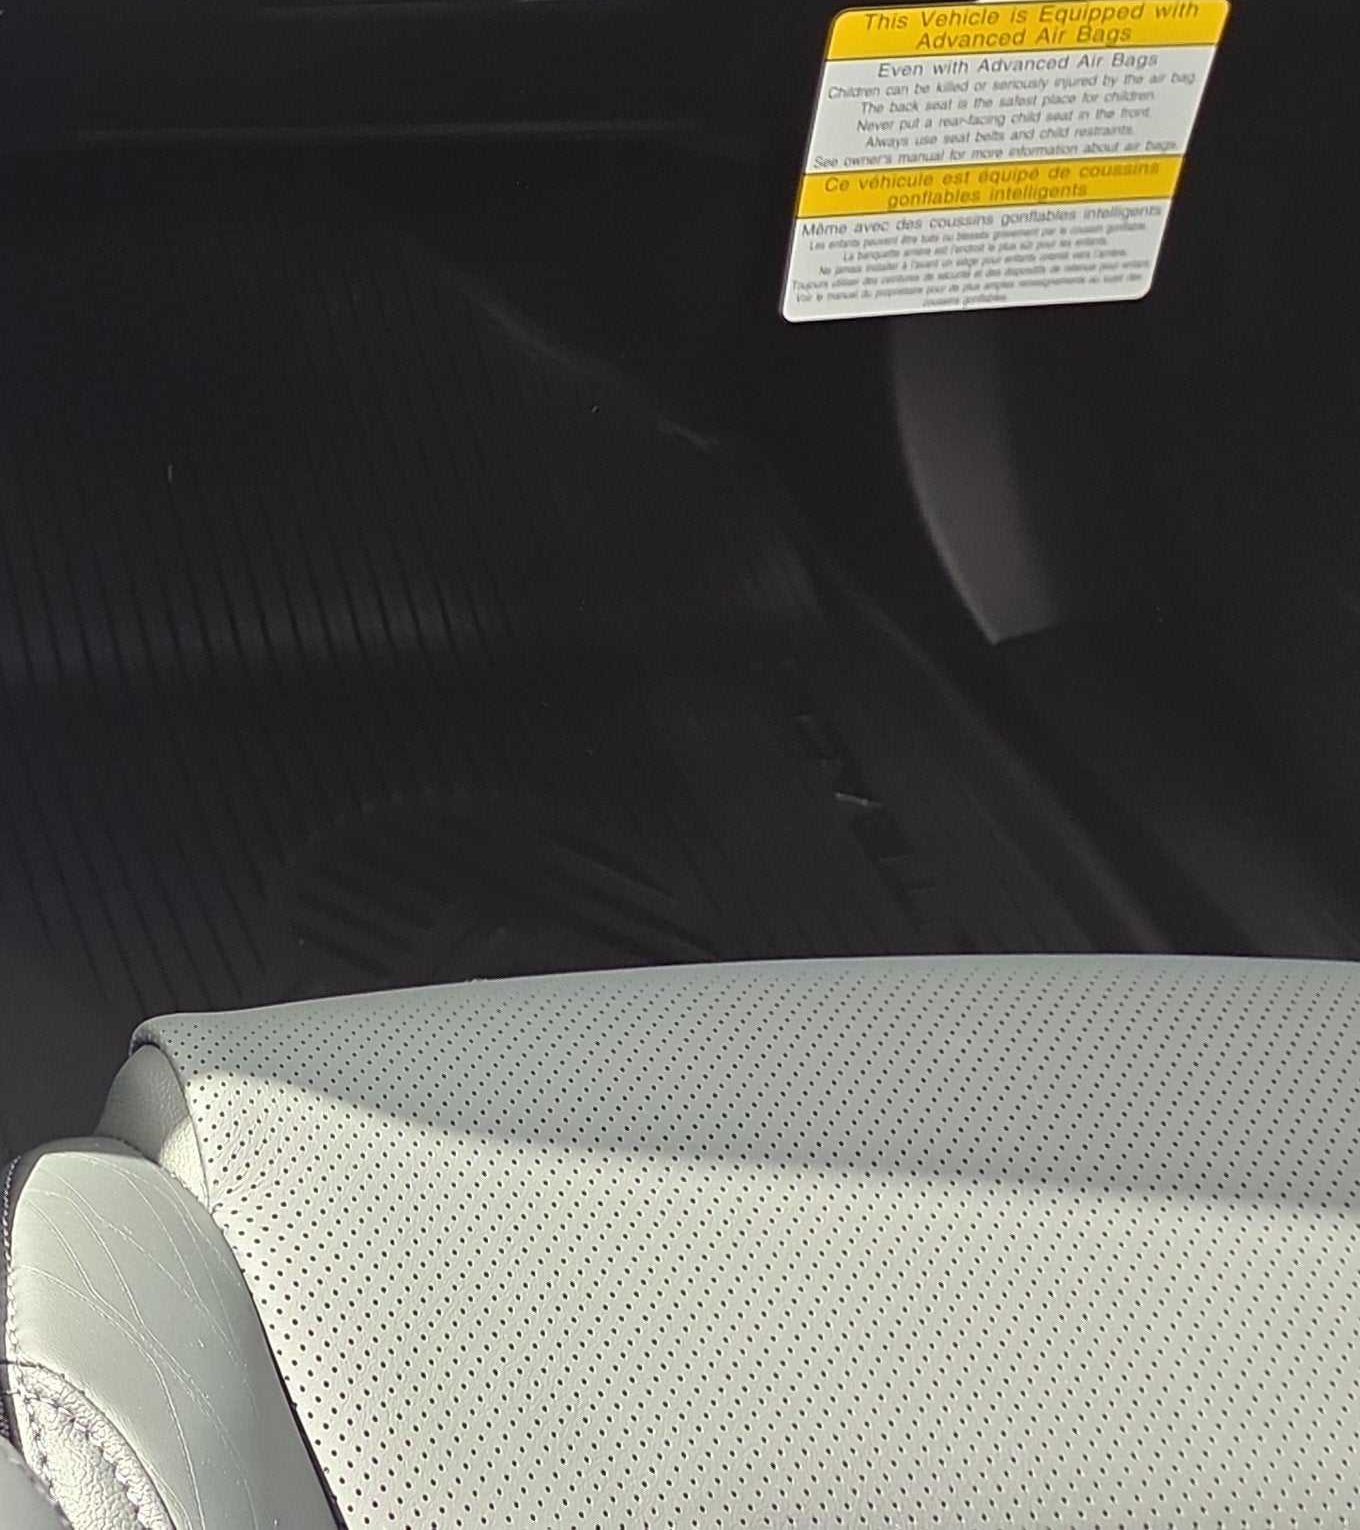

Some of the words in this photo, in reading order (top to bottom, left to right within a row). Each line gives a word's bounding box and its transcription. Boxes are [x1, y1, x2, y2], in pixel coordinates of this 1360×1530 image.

[864, 12, 909, 32] This
[920, 7, 1000, 28] Vehicle
[1009, 6, 1029, 24] is
[1038, 3, 1145, 27] Equipped
[1154, 1, 1200, 19] with
[915, 29, 1027, 50] Advanced
[1035, 26, 1067, 45] Air
[1076, 24, 1133, 44] Bags
[877, 62, 924, 78] Even
[932, 58, 969, 76] with
[977, 53, 1071, 72] Advanced
[1077, 52, 1102, 69] Air
[1111, 51, 1159, 69] Bags
[828, 85, 880, 99] Children
[885, 83, 909, 96] can
[914, 81, 931, 94] be
[861, 100, 884, 115] The
[888, 99, 919, 114] back
[856, 118, 894, 135] Never
[898, 117, 920, 133] put
[865, 134, 910, 151] Always
[914, 134, 938, 147] use
[1010, 126, 1035, 141] and
[814, 154, 839, 169] See
[824, 176, 850, 193] Ce
[941, 170, 971, 186] est
[1047, 164, 1071, 180] de
[1079, 161, 1160, 179] coussins
[886, 188, 982, 209] gonflables
[989, 182, 1088, 203] intelligents
[853, 219, 890, 233] avec
[895, 217, 923, 232] des
